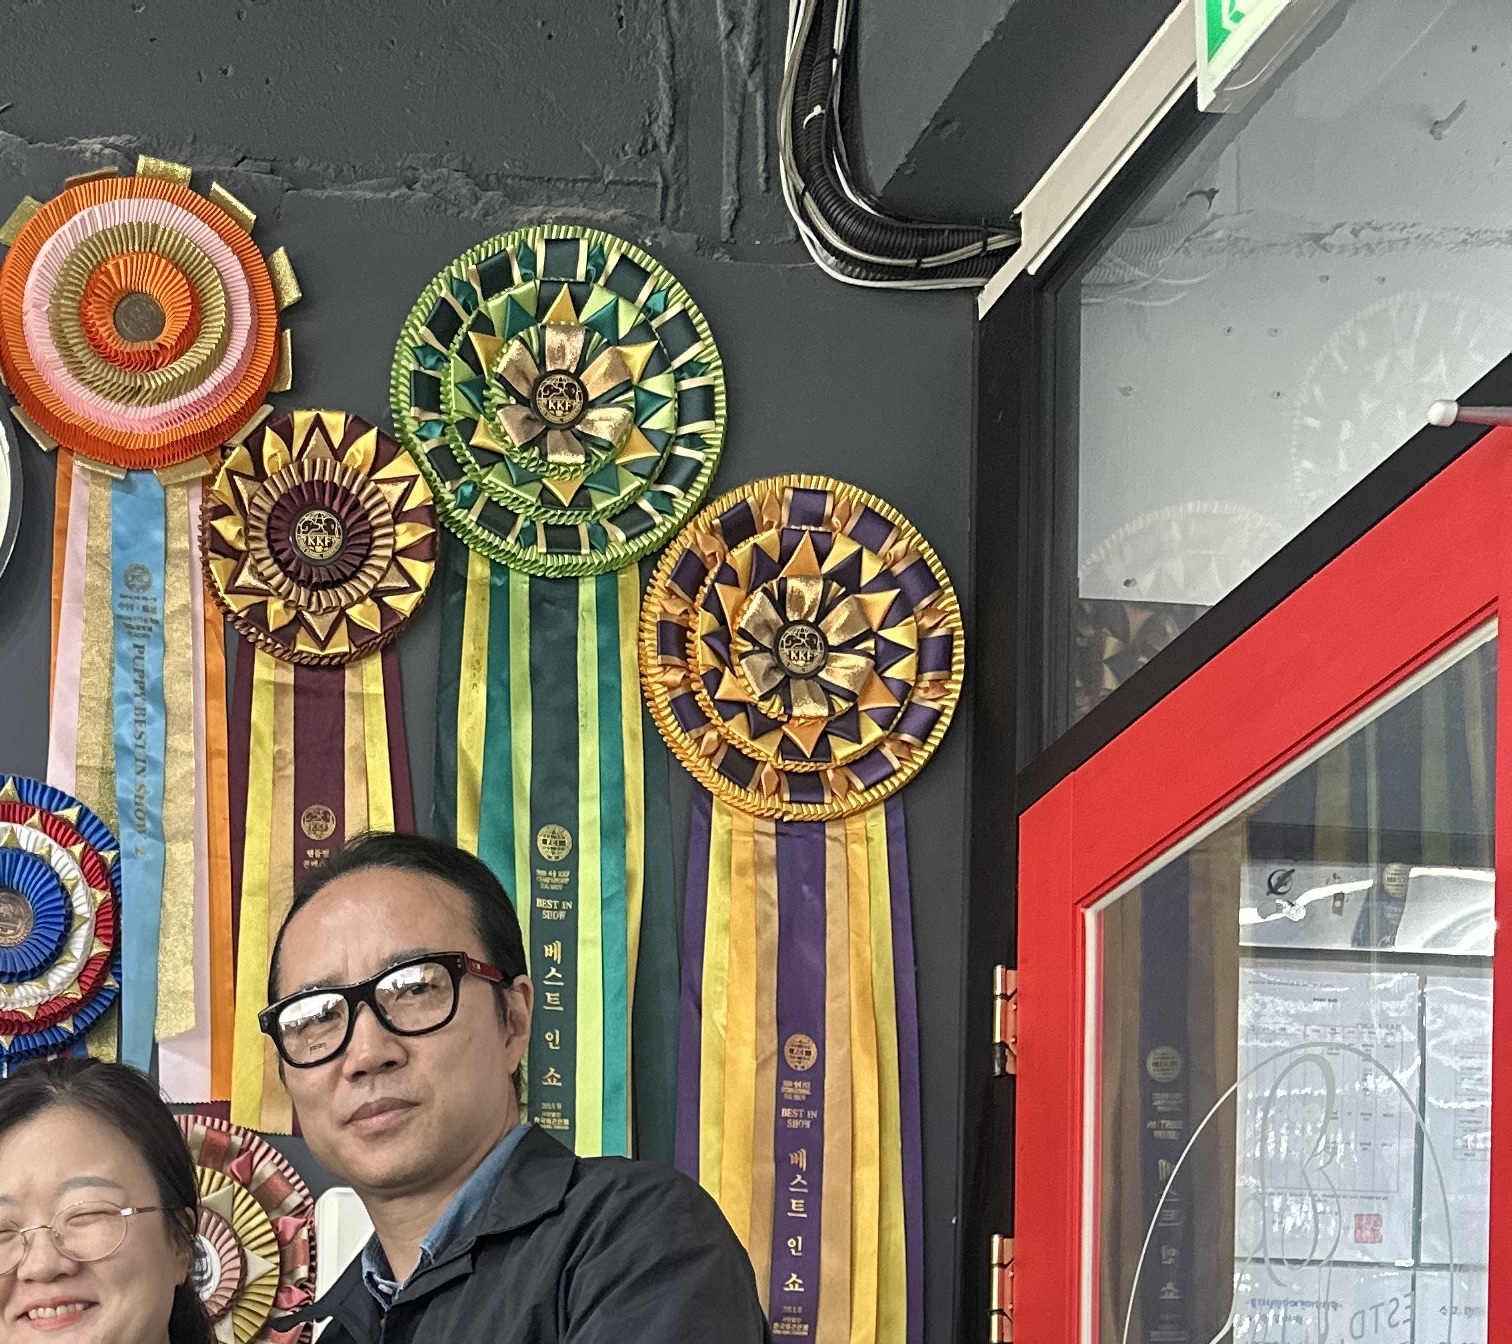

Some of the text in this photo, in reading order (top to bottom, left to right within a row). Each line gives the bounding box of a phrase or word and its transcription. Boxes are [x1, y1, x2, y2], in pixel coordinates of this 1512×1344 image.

[548, 400, 573, 411] KKF
[307, 536, 331, 547] KKF
[132, 643, 147, 698] PUPPY
[133, 700, 148, 748] BEST
[134, 784, 147, 836] SHOW
[536, 898, 573, 910] BEST IN
[541, 910, 567, 920] SHOW
[543, 940, 565, 1011] 베스트
[545, 1029, 561, 1050] 인
[542, 1067, 563, 1087] 쇼
[781, 1108, 818, 1119] BEST IN
[787, 1119, 810, 1129] SHOW
[787, 1148, 810, 1218] 베스트
[787, 1237, 804, 1257] 인
[783, 1273, 806, 1293] 쇼
